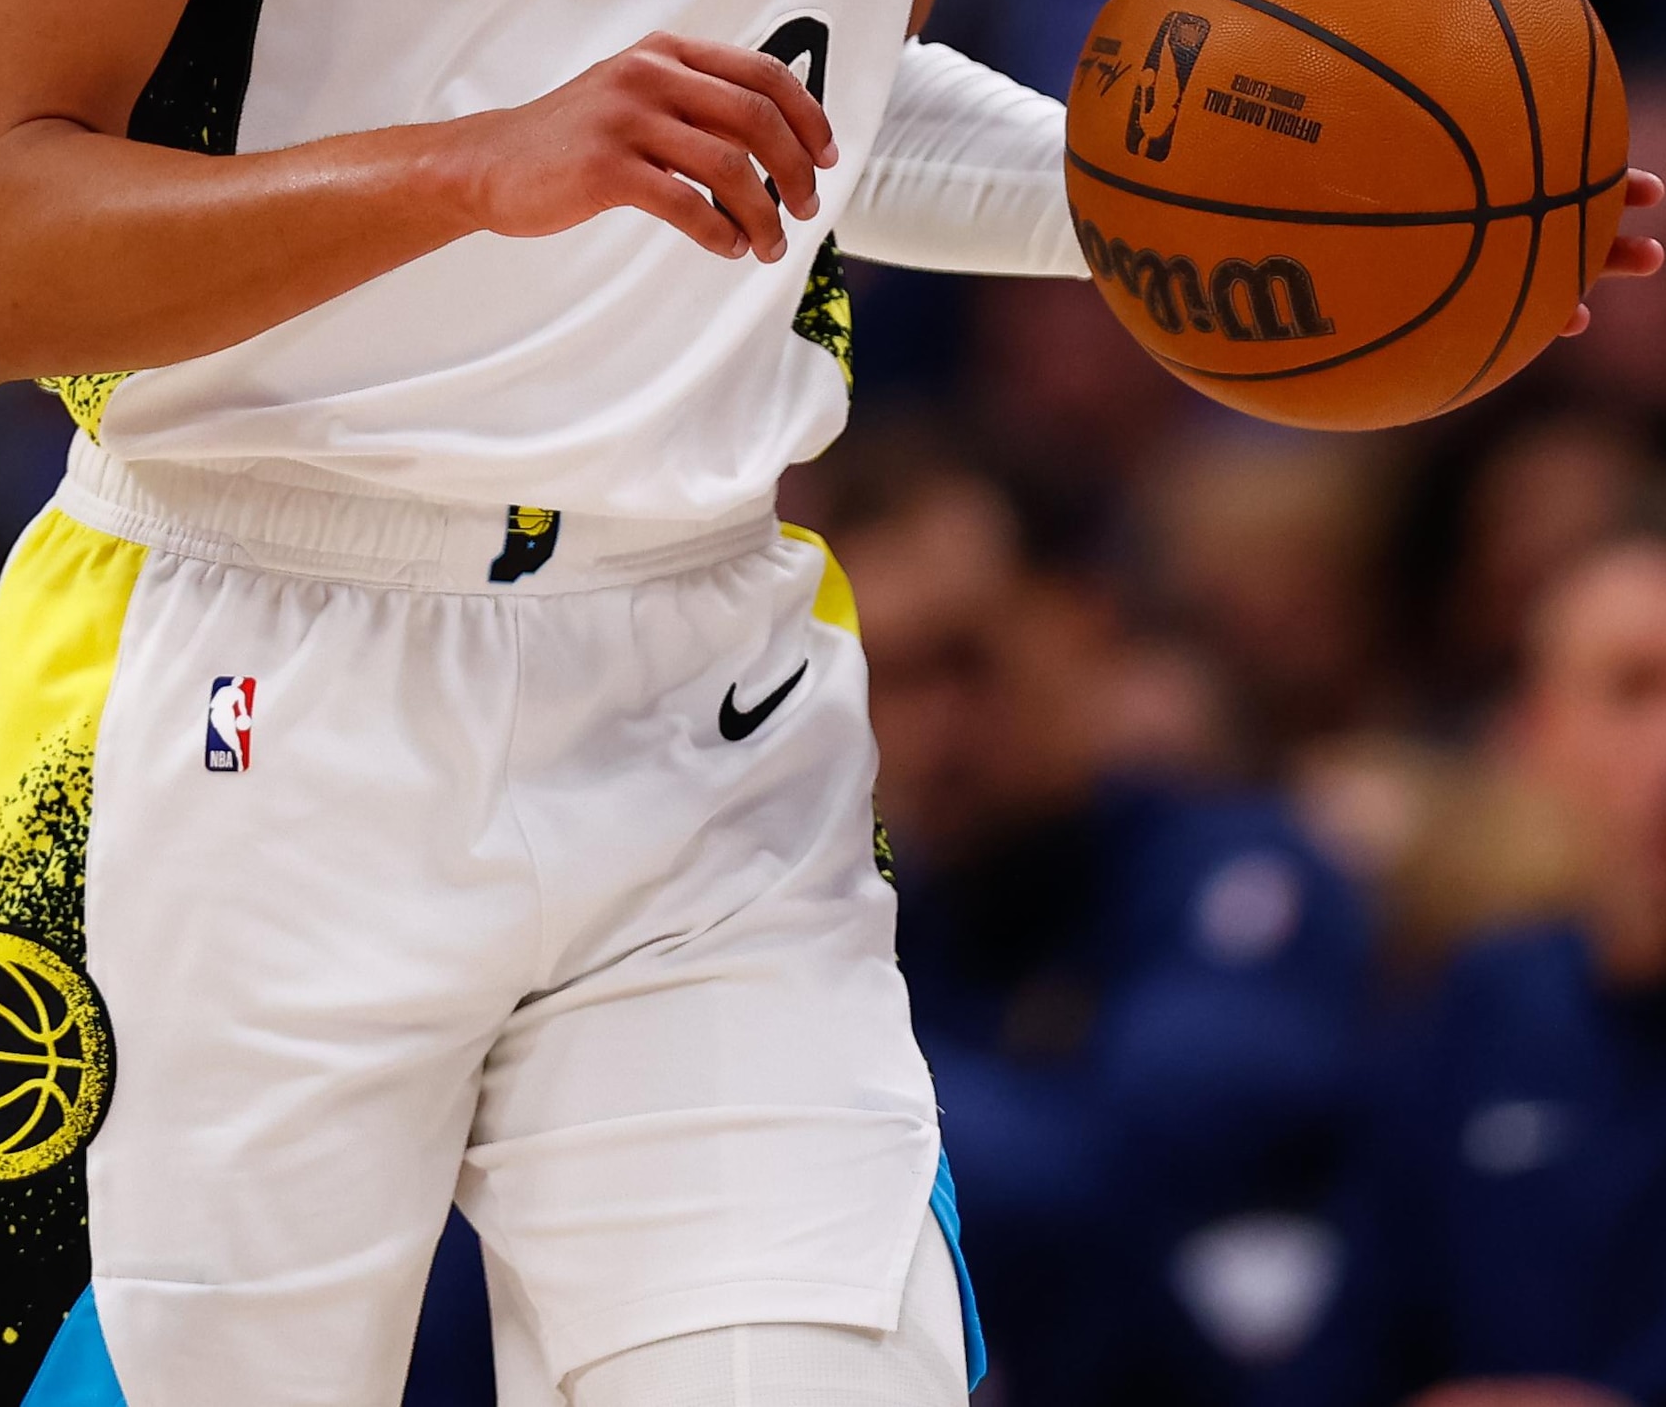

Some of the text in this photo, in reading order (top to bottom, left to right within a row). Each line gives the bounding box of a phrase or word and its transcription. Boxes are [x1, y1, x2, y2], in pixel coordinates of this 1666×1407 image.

[1203, 88, 1233, 116] BALL
[1229, 97, 1267, 126] GAME
[1266, 107, 1322, 143] OFFICIAL
[1072, 206, 1336, 342] Wilso
[209, 749, 234, 768] NBA
